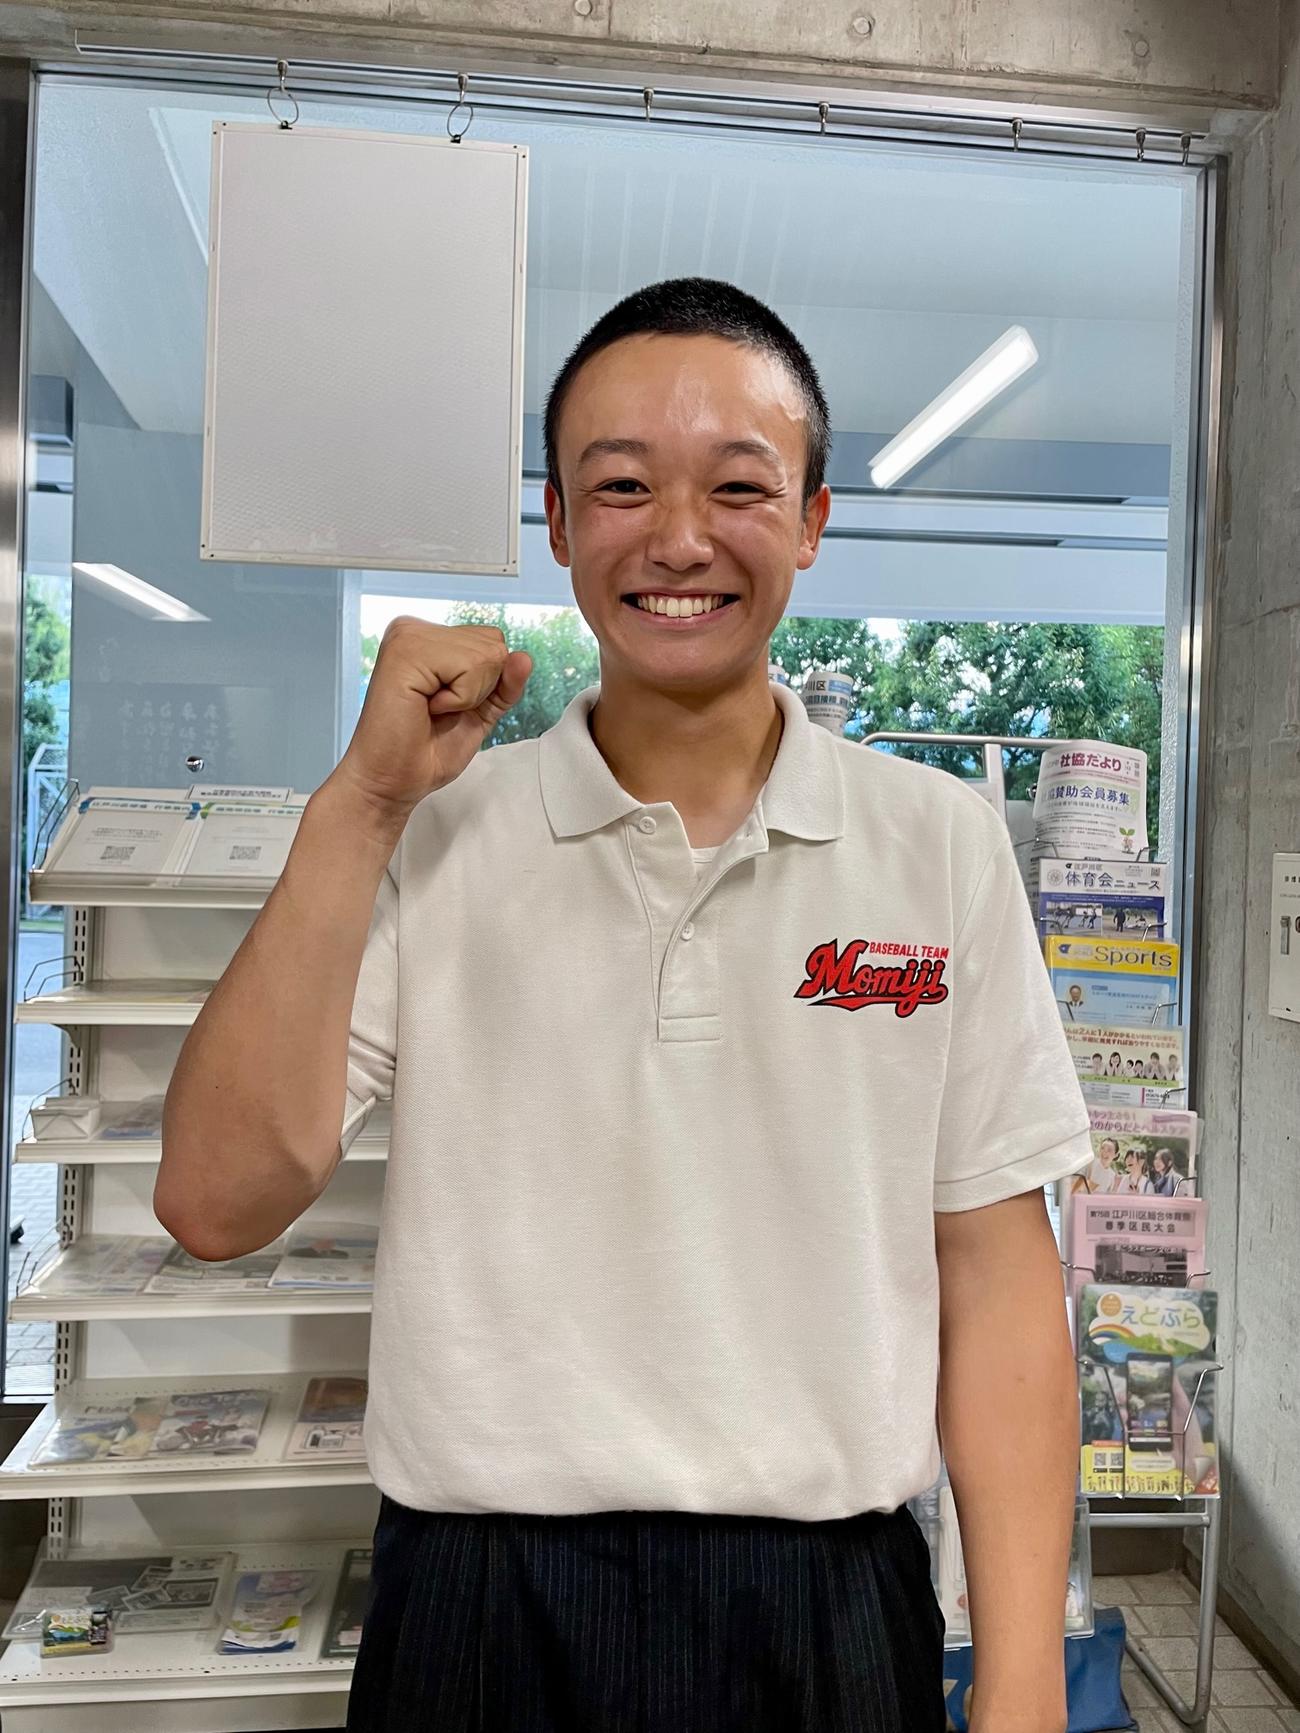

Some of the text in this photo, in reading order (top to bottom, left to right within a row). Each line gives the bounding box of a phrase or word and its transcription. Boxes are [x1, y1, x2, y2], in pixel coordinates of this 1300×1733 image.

[1060, 752, 1122, 771] 社協だより
[1065, 870, 1161, 890] 体育会ニュース
[869, 942, 949, 959] BASEBALL TEAM
[1095, 945, 1172, 967] Sports
[793, 938, 949, 1018] Momiji
[1121, 1305, 1201, 1329] えどぶら
